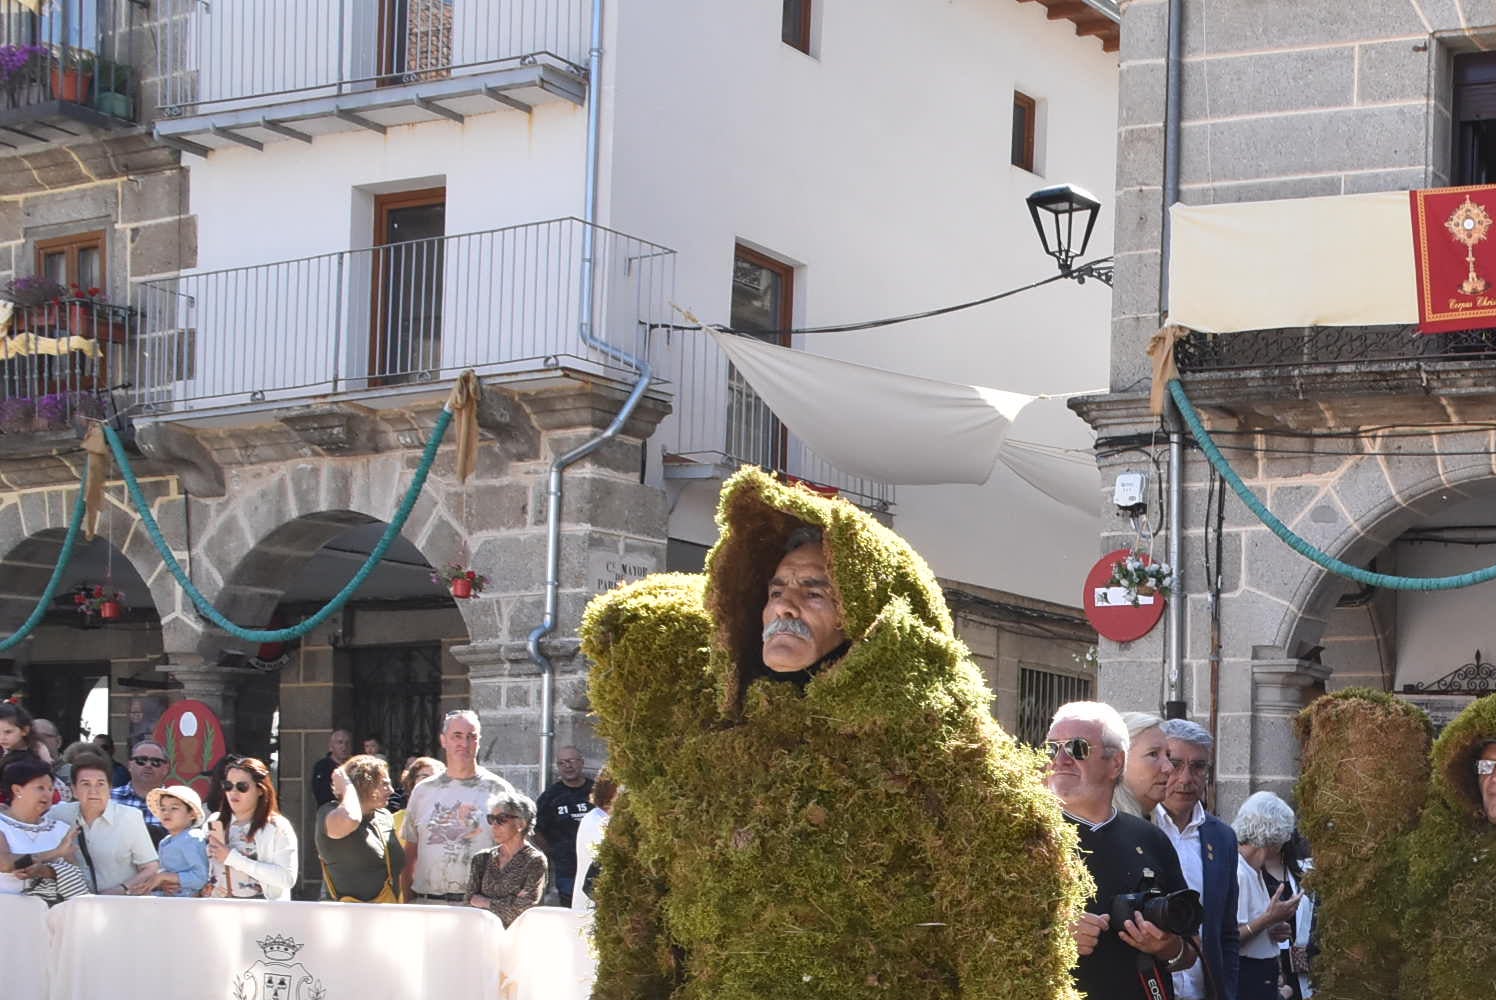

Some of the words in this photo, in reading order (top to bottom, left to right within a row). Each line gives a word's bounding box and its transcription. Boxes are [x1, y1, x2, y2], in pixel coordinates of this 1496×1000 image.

[1449, 298, 1473, 311] Corpus
[621, 563, 648, 577] MAYOR
[557, 805, 569, 815] 21
[576, 802, 588, 812] 15
